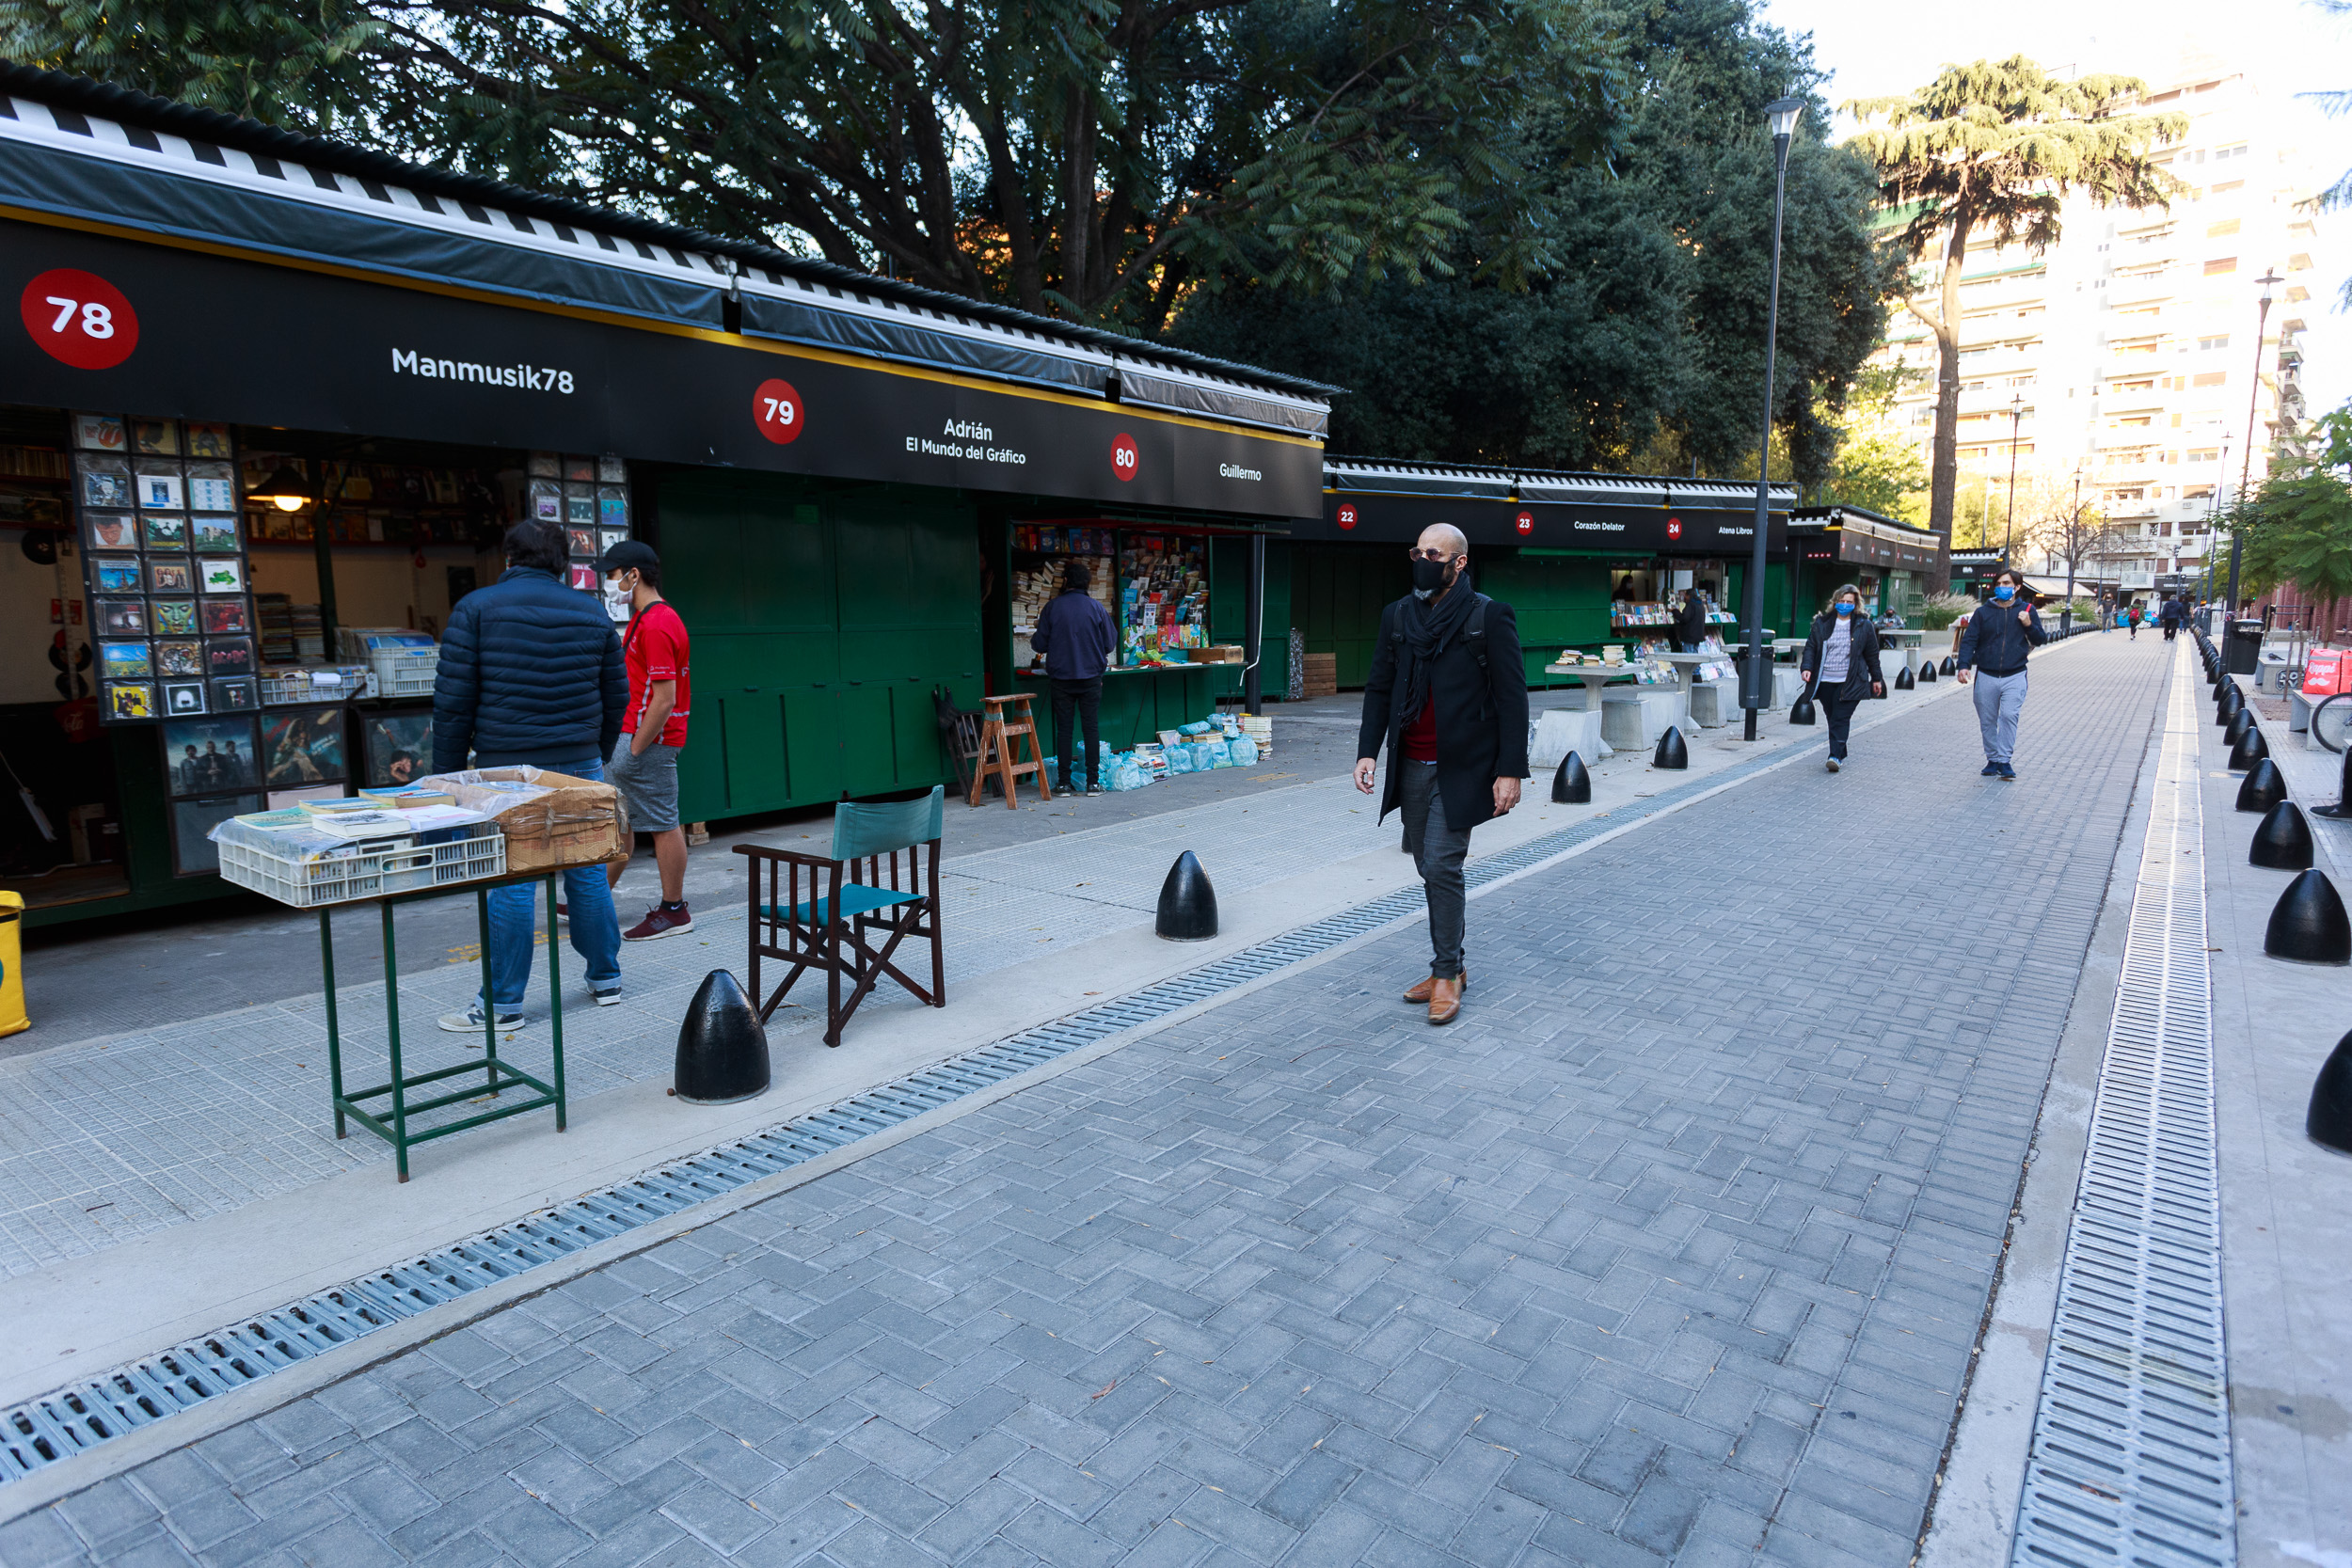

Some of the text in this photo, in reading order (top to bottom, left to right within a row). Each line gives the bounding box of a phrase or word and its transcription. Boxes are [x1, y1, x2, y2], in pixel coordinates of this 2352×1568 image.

[46, 296, 115, 340] 78
[391, 347, 575, 394] Manmusik78
[763, 397, 794, 424] 79
[944, 418, 993, 441] Adrián
[906, 436, 1026, 465] El Mundo del Gráfico
[1115, 448, 1135, 468] 80
[1219, 463, 1263, 482] Guillermo
[1341, 511, 1354, 522] 22
[1518, 518, 1531, 529] 23
[1574, 520, 1626, 531] Corazón Delator
[1669, 524, 1679, 533] 24
[1718, 526, 1754, 535] Atena Libros
[2308, 661, 2337, 675] Rappi
